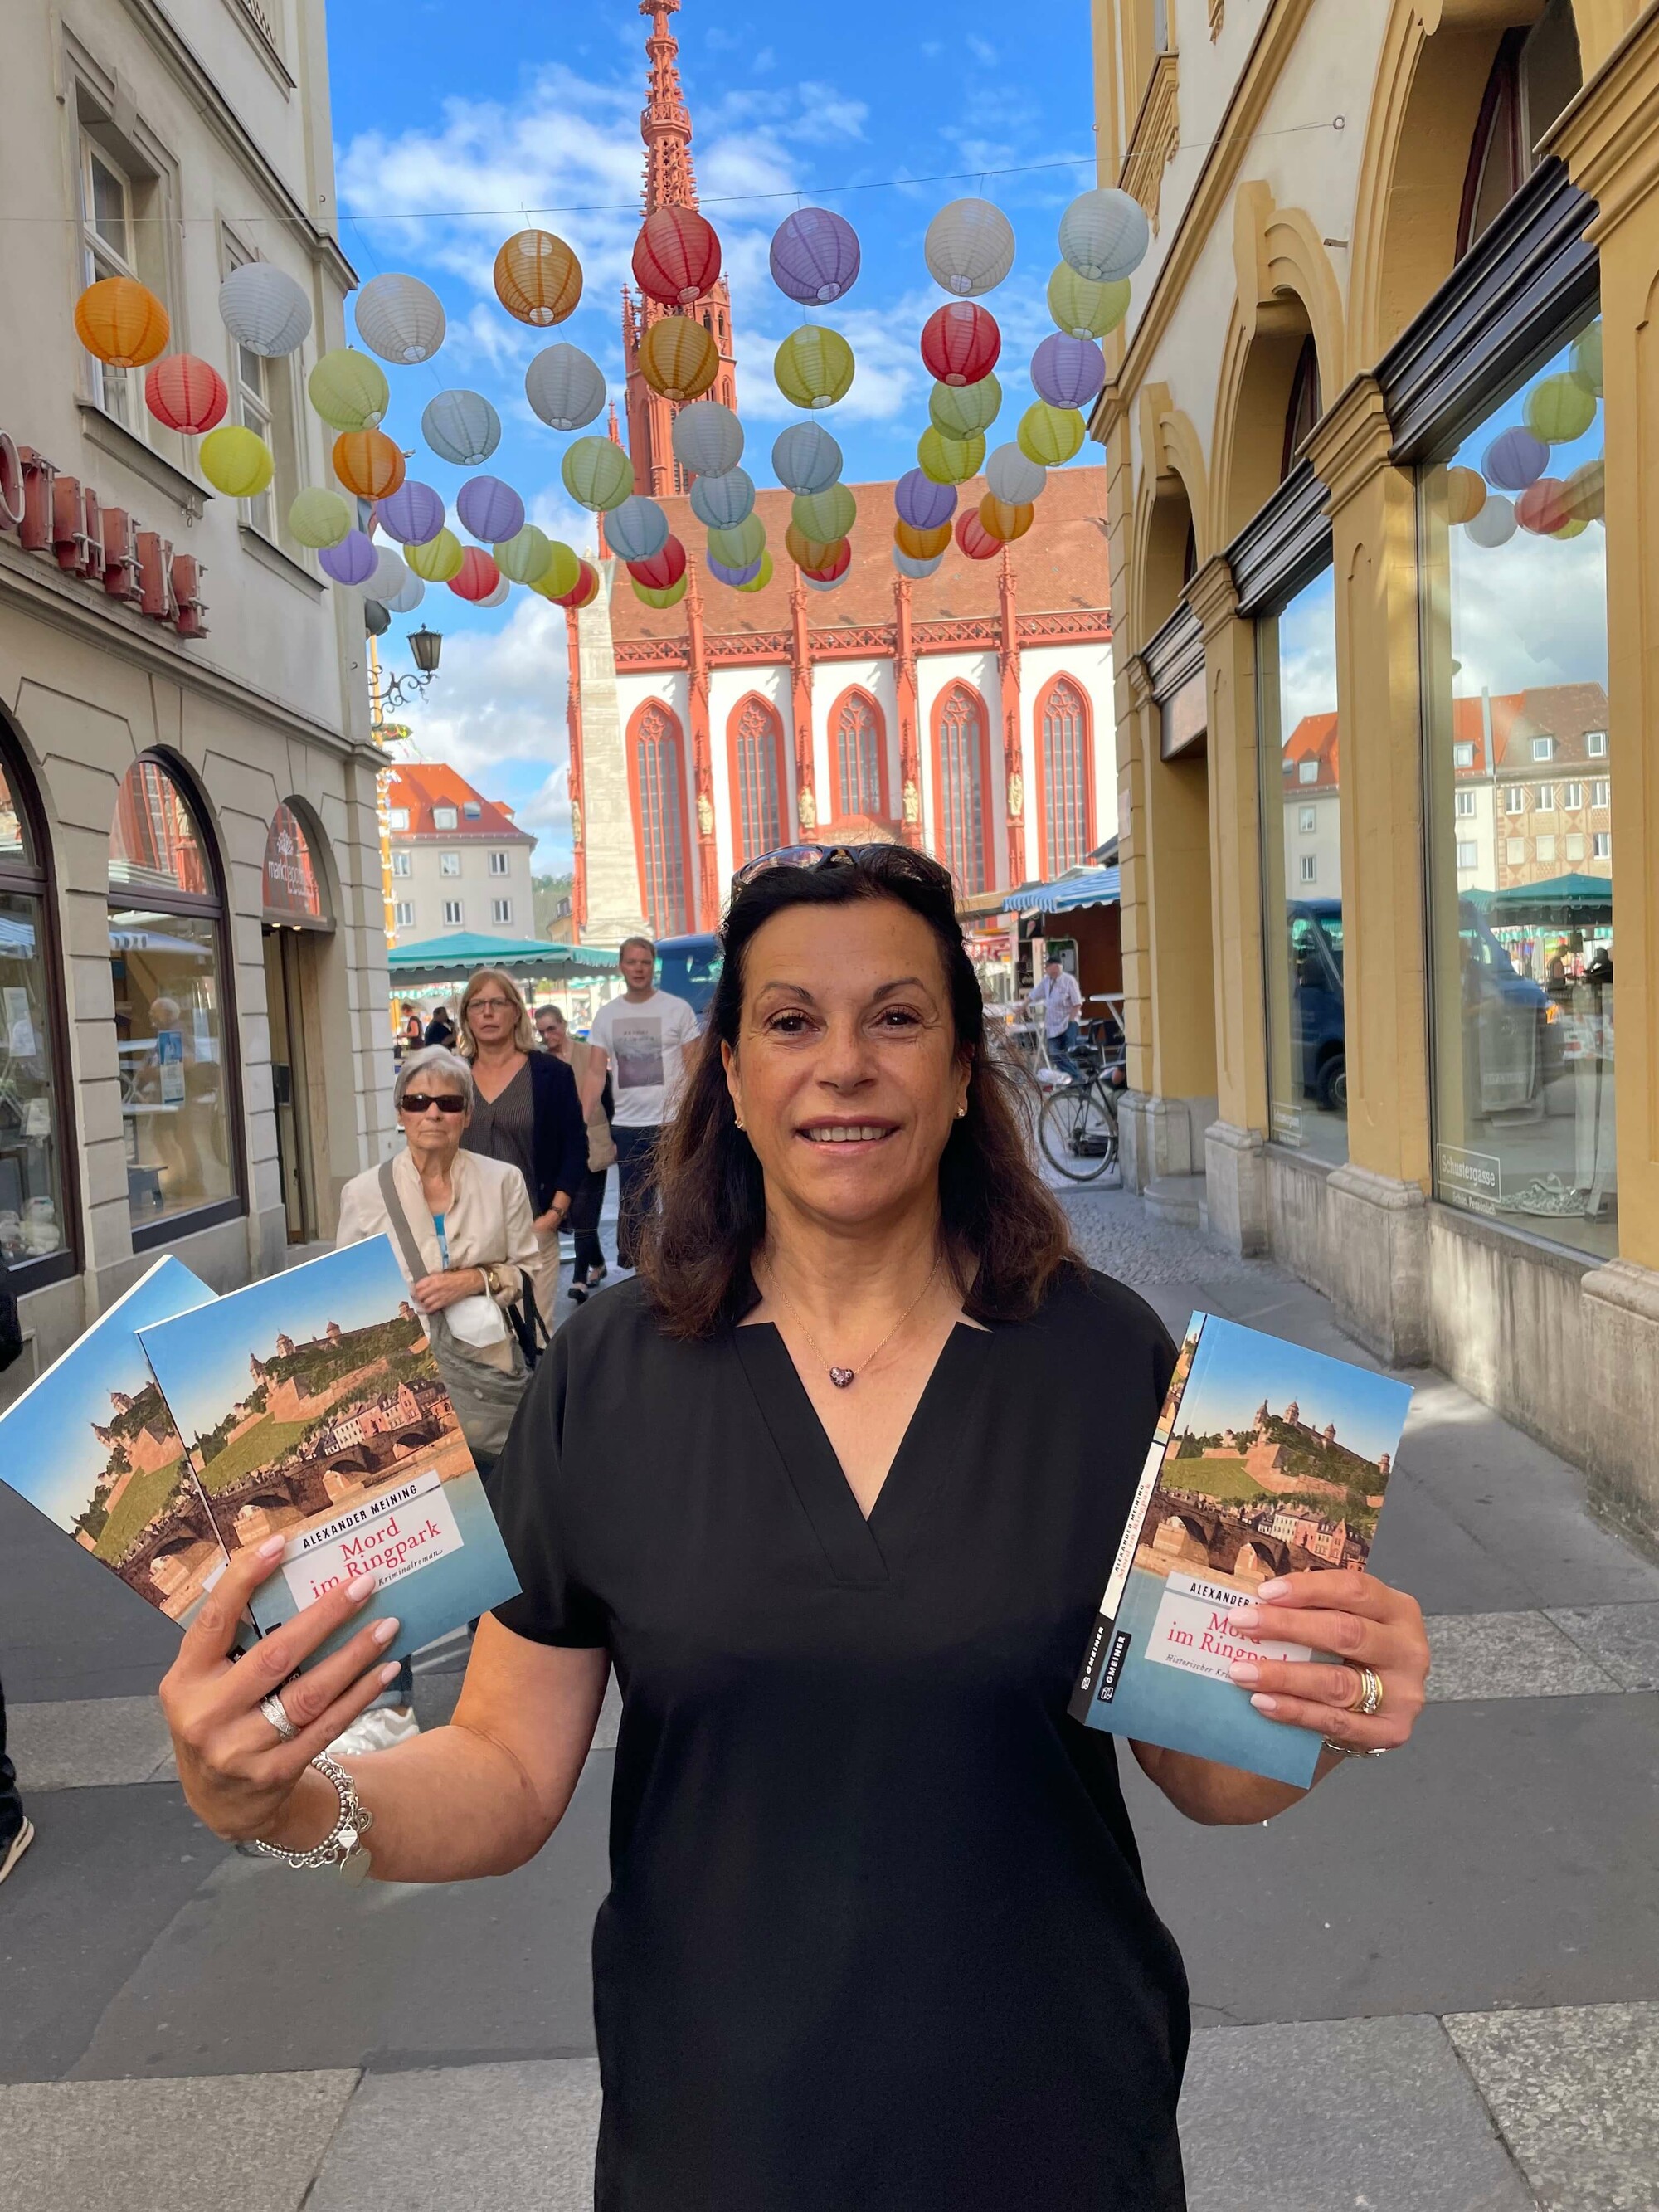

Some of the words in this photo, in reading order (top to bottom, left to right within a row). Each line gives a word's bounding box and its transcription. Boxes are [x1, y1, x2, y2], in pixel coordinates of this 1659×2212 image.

[1442, 1153, 1496, 1187] Schustergasse
[303, 1509, 367, 1549] ALEXANDER
[370, 1484, 417, 1515] MEINING
[1115, 1523, 1132, 1572] ALEXANDER
[1130, 1484, 1145, 1521] MEINING
[308, 1576, 339, 1600] im
[343, 1519, 442, 1578] Ringpark
[338, 1516, 401, 1562] Mord
[378, 1549, 444, 1586] Kriminalroman
[1190, 1582, 1250, 1607] ALEXANDER
[1167, 1621, 1194, 1647] im
[1106, 1635, 1126, 1684] GMEINER
[1165, 1654, 1214, 1674] Historischer
